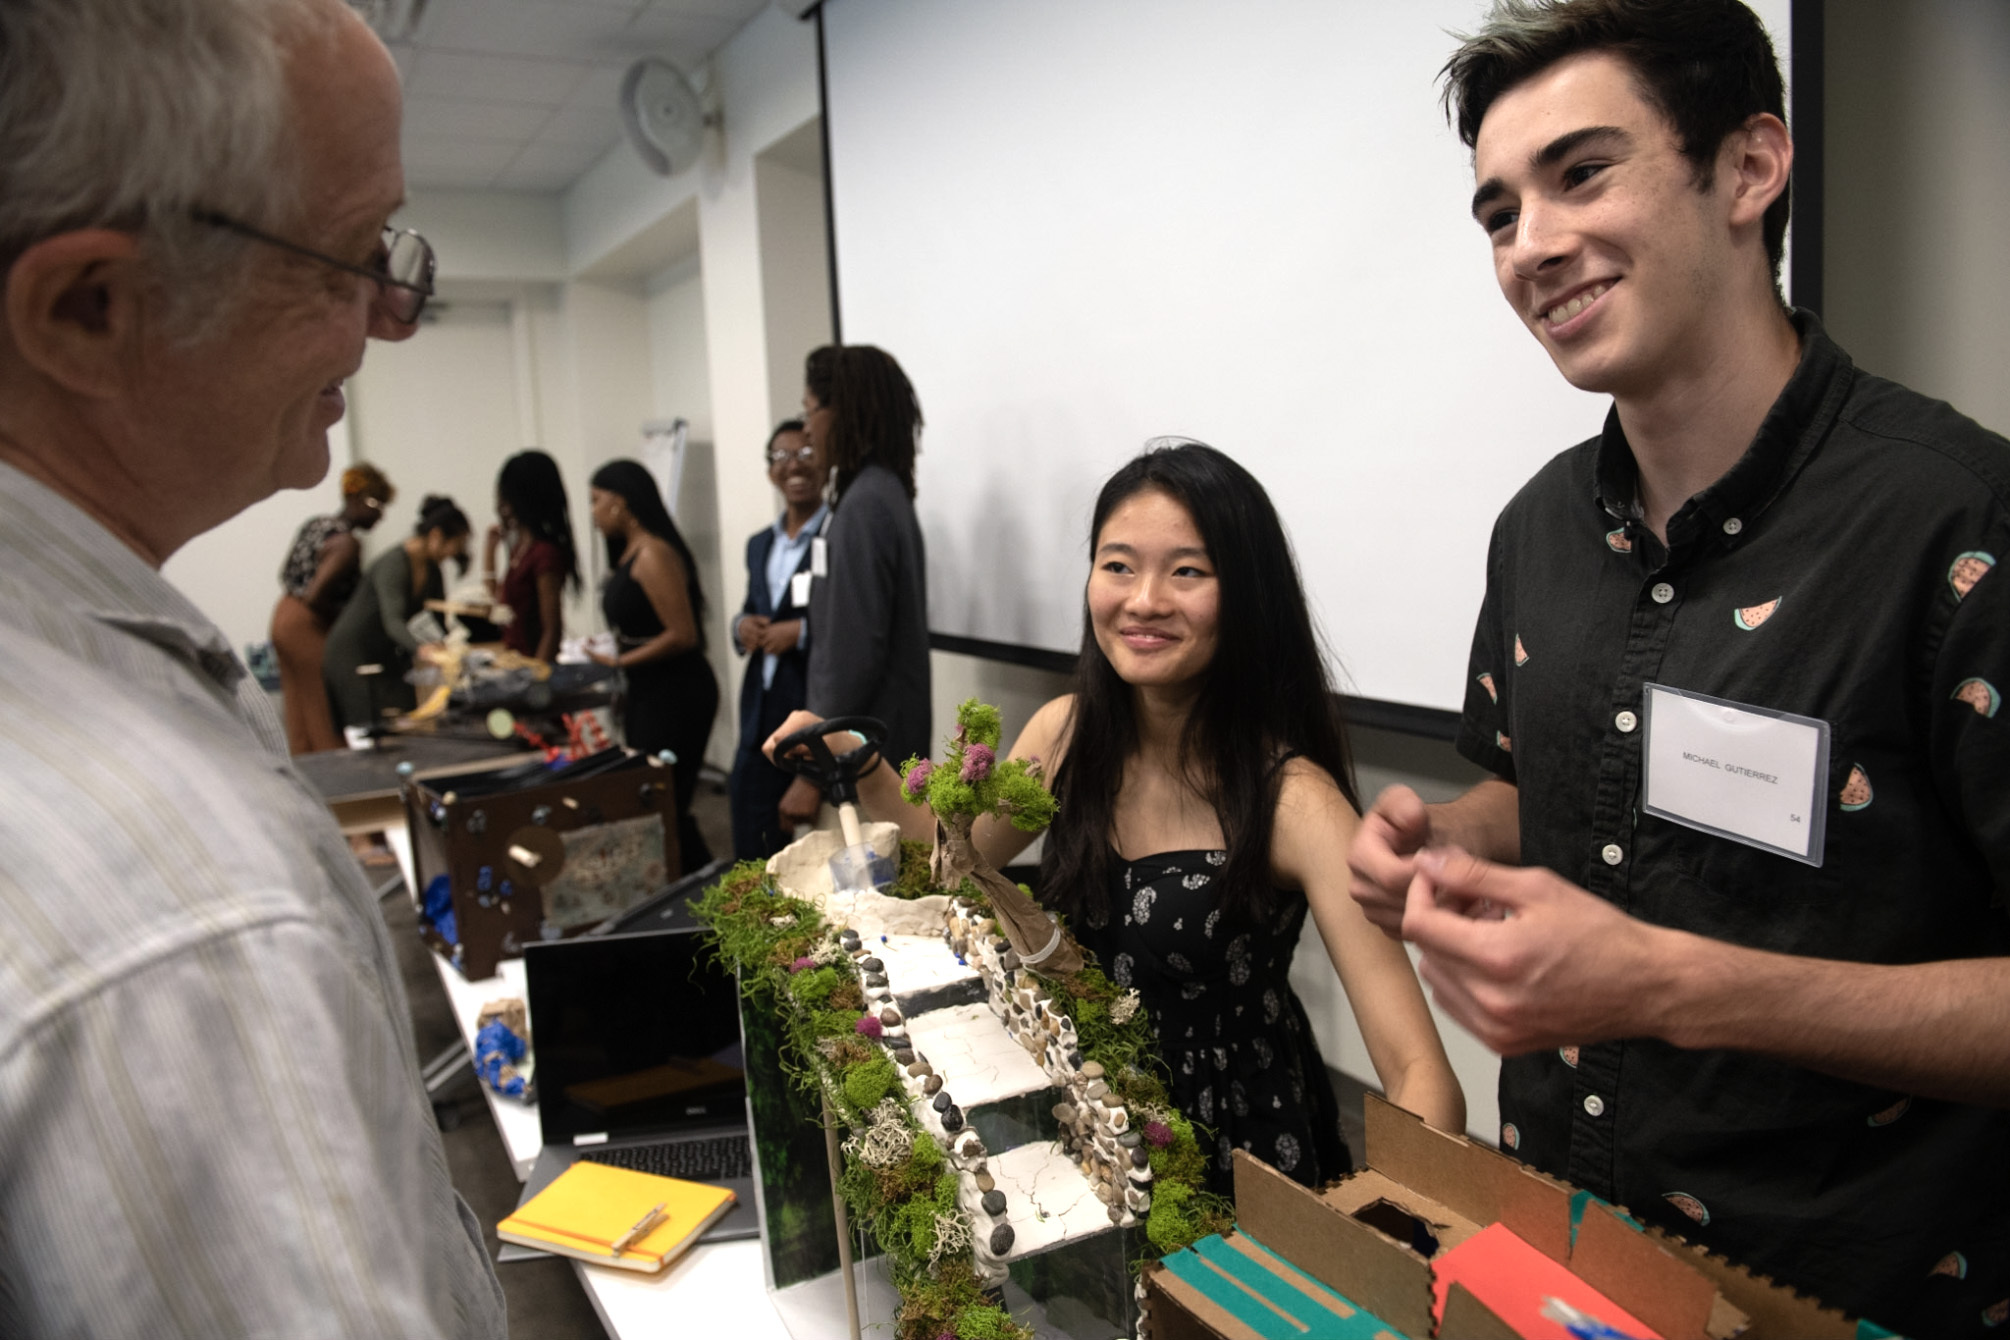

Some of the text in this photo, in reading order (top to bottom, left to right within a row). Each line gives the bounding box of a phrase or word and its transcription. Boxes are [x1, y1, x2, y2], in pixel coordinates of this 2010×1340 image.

[1683, 752, 1778, 784] MICHAEL GUTIERREZ
[1790, 814, 1801, 823] 54
